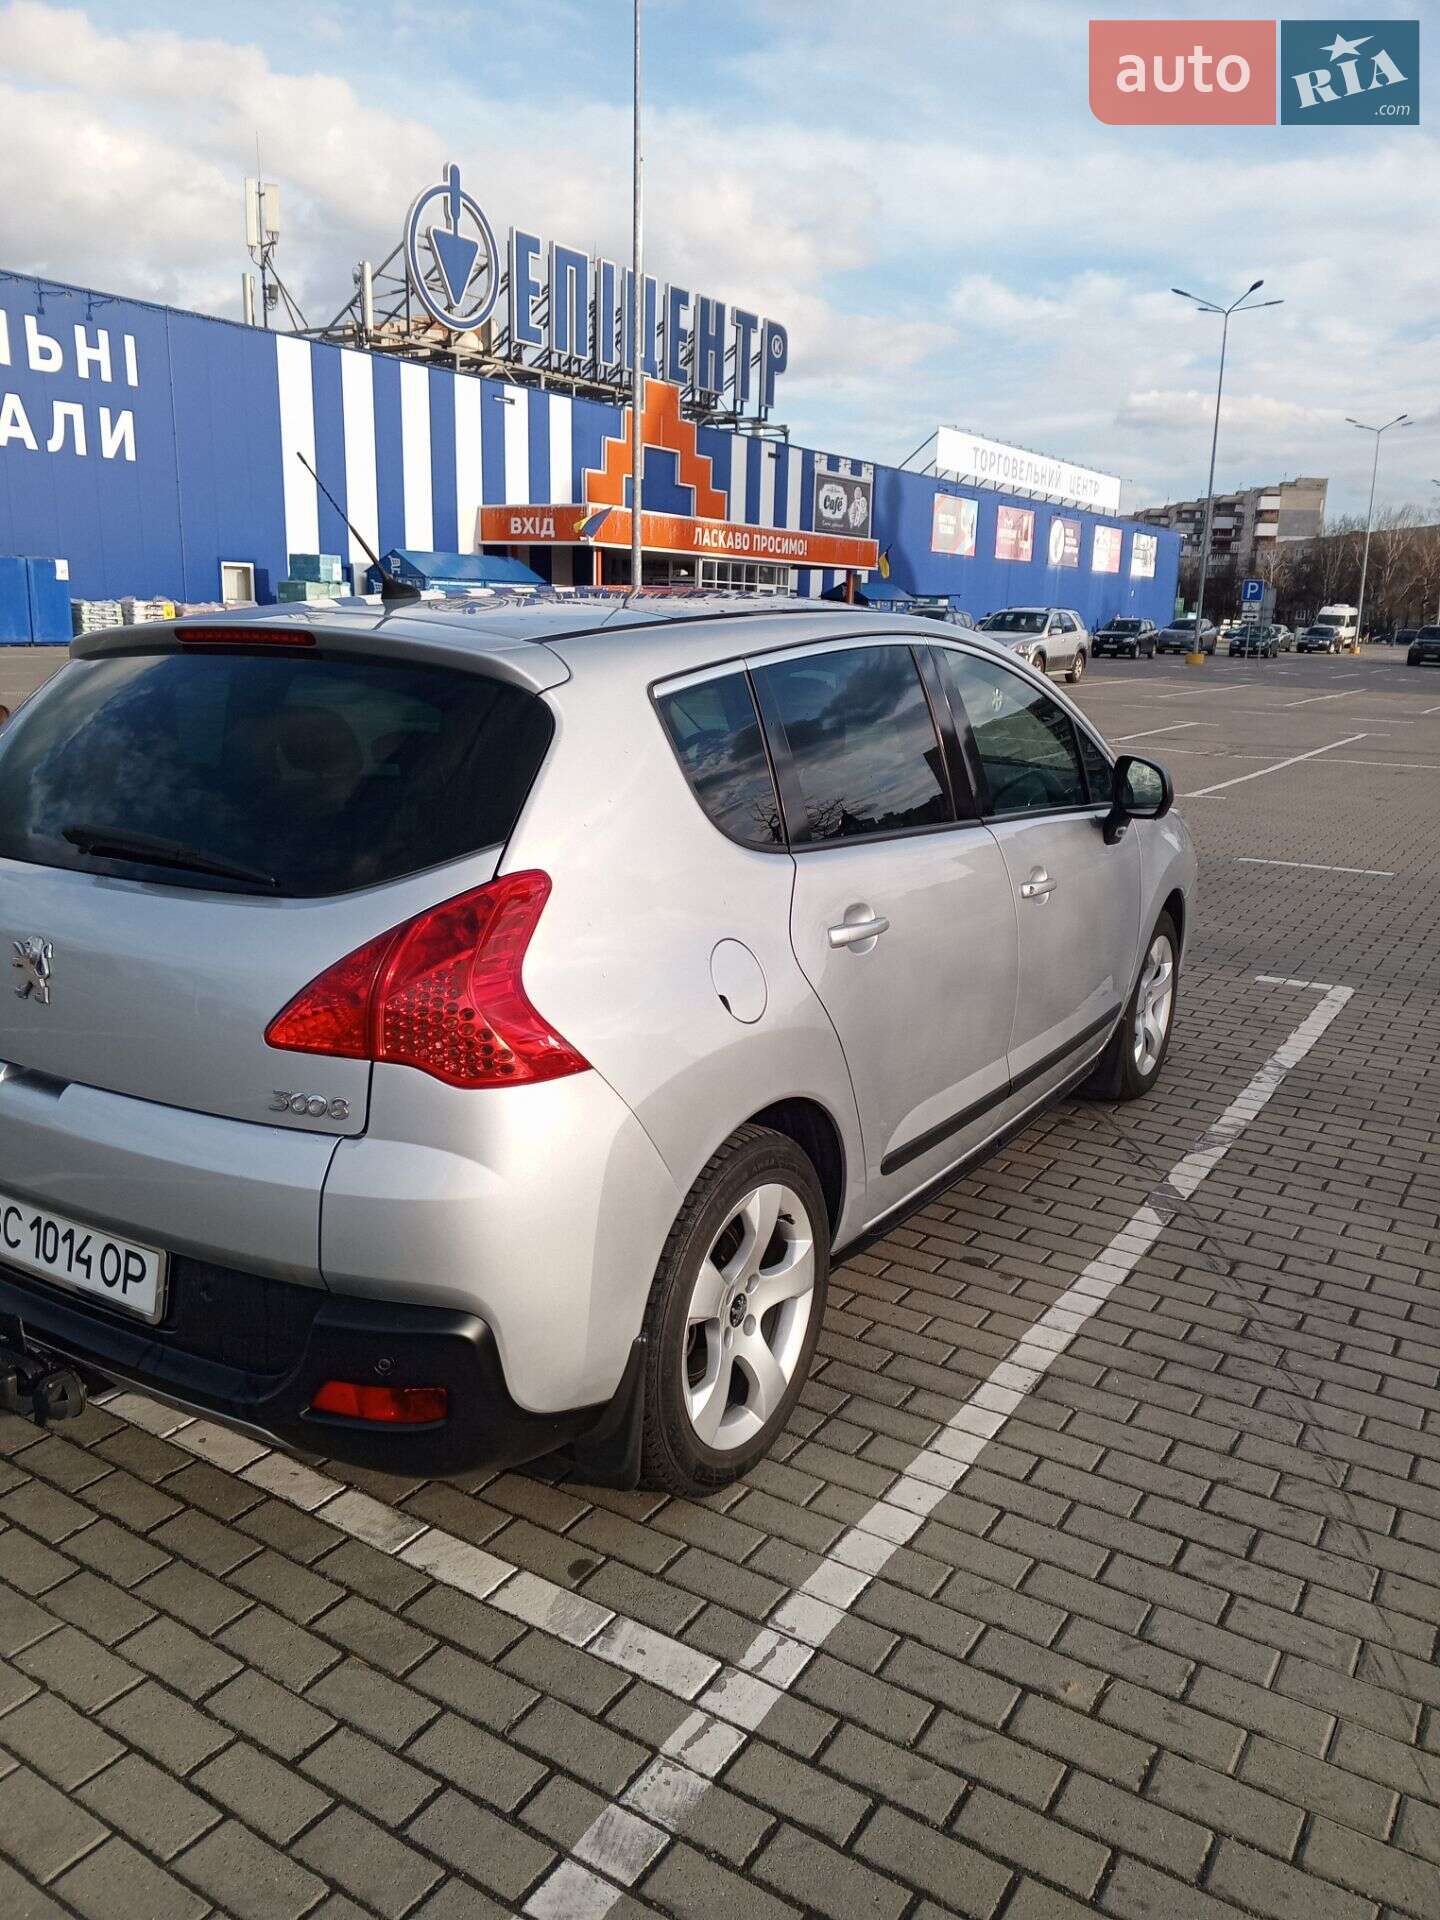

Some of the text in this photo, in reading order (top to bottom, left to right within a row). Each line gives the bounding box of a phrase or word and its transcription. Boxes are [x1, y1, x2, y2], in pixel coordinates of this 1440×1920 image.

[509, 226, 789, 408] ЕПІЦЕНТР
[0, 392, 137, 462] АЛИ
[973, 446, 1099, 497] ТОРГОВЕЛЬНИЙ ЦЕНТР
[823, 495, 843, 514] Café
[510, 516, 555, 538] ВХІД
[693, 527, 808, 556] ЛАСКАВО ПРОСИМО!
[1247, 582, 1259, 598] P
[269, 1089, 349, 1120] 3008
[0, 1206, 23, 1249] C
[29, 1215, 93, 1279] 1014
